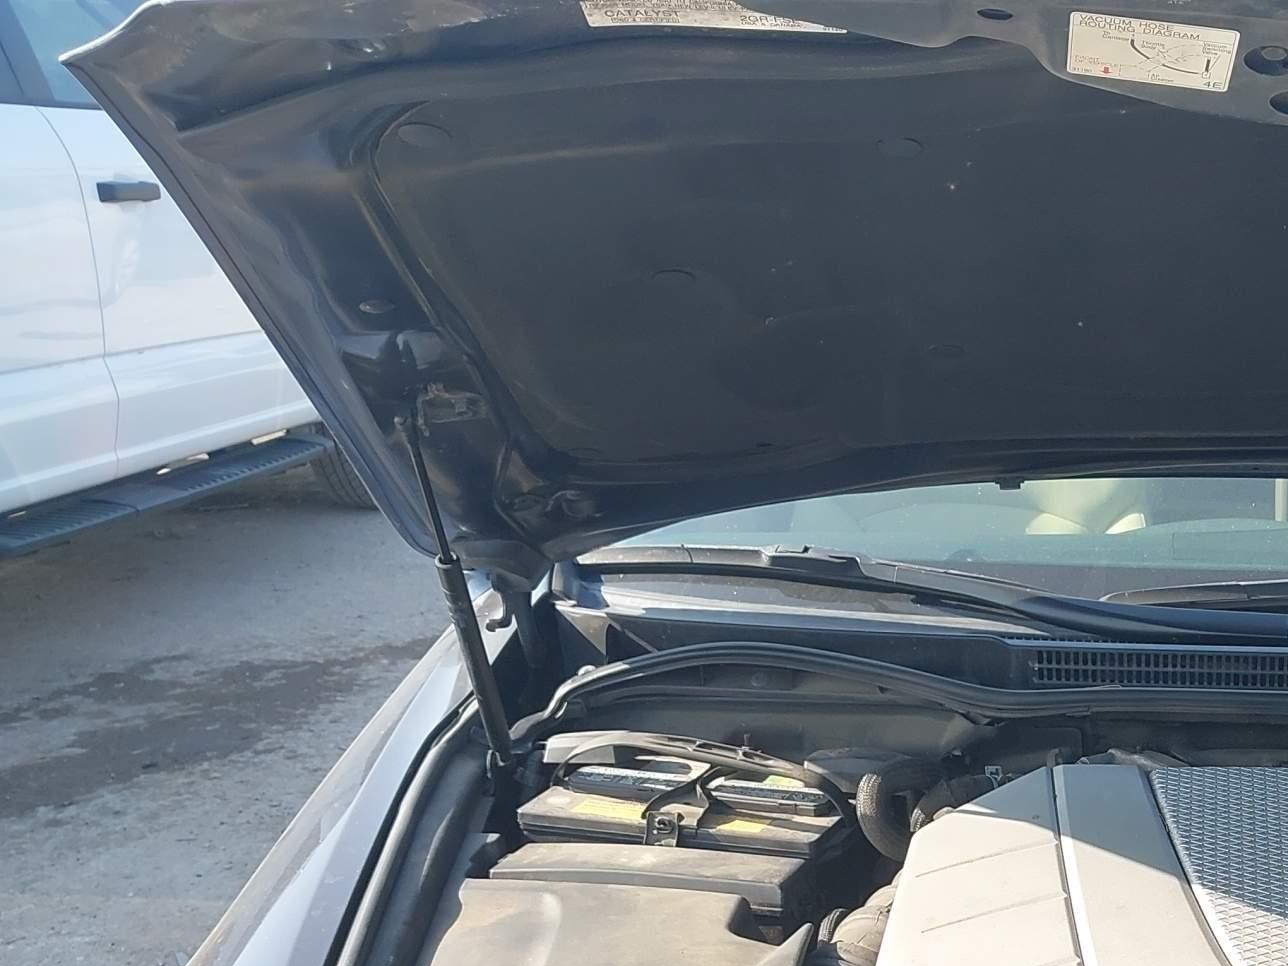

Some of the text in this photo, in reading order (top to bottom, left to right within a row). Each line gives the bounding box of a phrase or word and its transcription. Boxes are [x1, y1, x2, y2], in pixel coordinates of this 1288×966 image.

[604, 9, 681, 18] CATALYST
[1079, 14, 1175, 32] VACUUM HOSE
[1079, 20, 1136, 34] ROUTING
[1143, 27, 1200, 41] DIAGRAM
[1202, 81, 1223, 89] 4E
